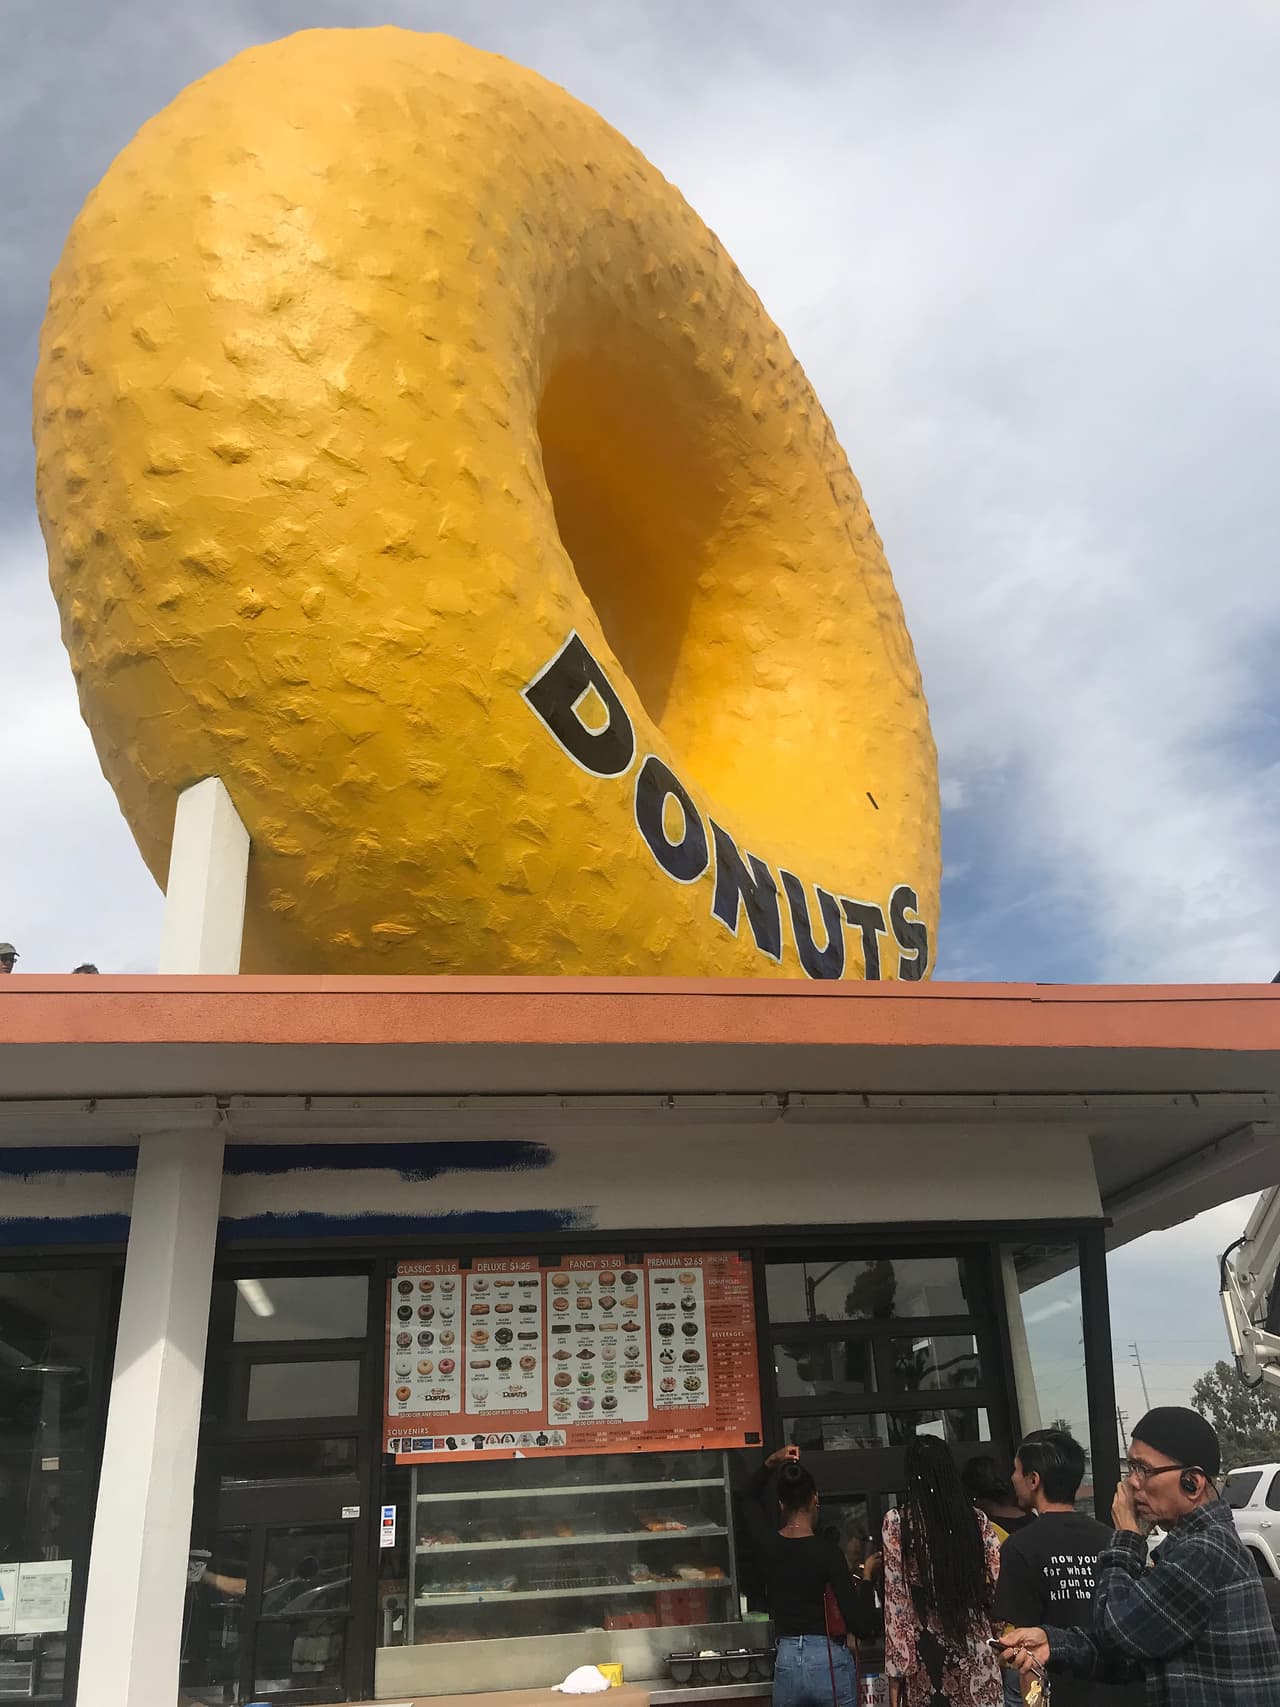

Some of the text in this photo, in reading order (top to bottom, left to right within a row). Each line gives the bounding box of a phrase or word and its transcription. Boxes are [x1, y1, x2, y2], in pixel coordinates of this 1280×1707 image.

[520, 628, 930, 981] DONUTS
[569, 1260, 597, 1269] FANCY
[647, 1258, 681, 1267] PREMIUM
[397, 1265, 432, 1274] CLASSIC
[477, 1263, 507, 1272] DELUXE
[387, 1427, 429, 1436] SOUVENIRS
[1050, 1555, 1097, 1565] now you
[1043, 1565, 1092, 1577] for what
[1059, 1578, 1095, 1589] gun to
[1050, 1589, 1070, 1600] kill
